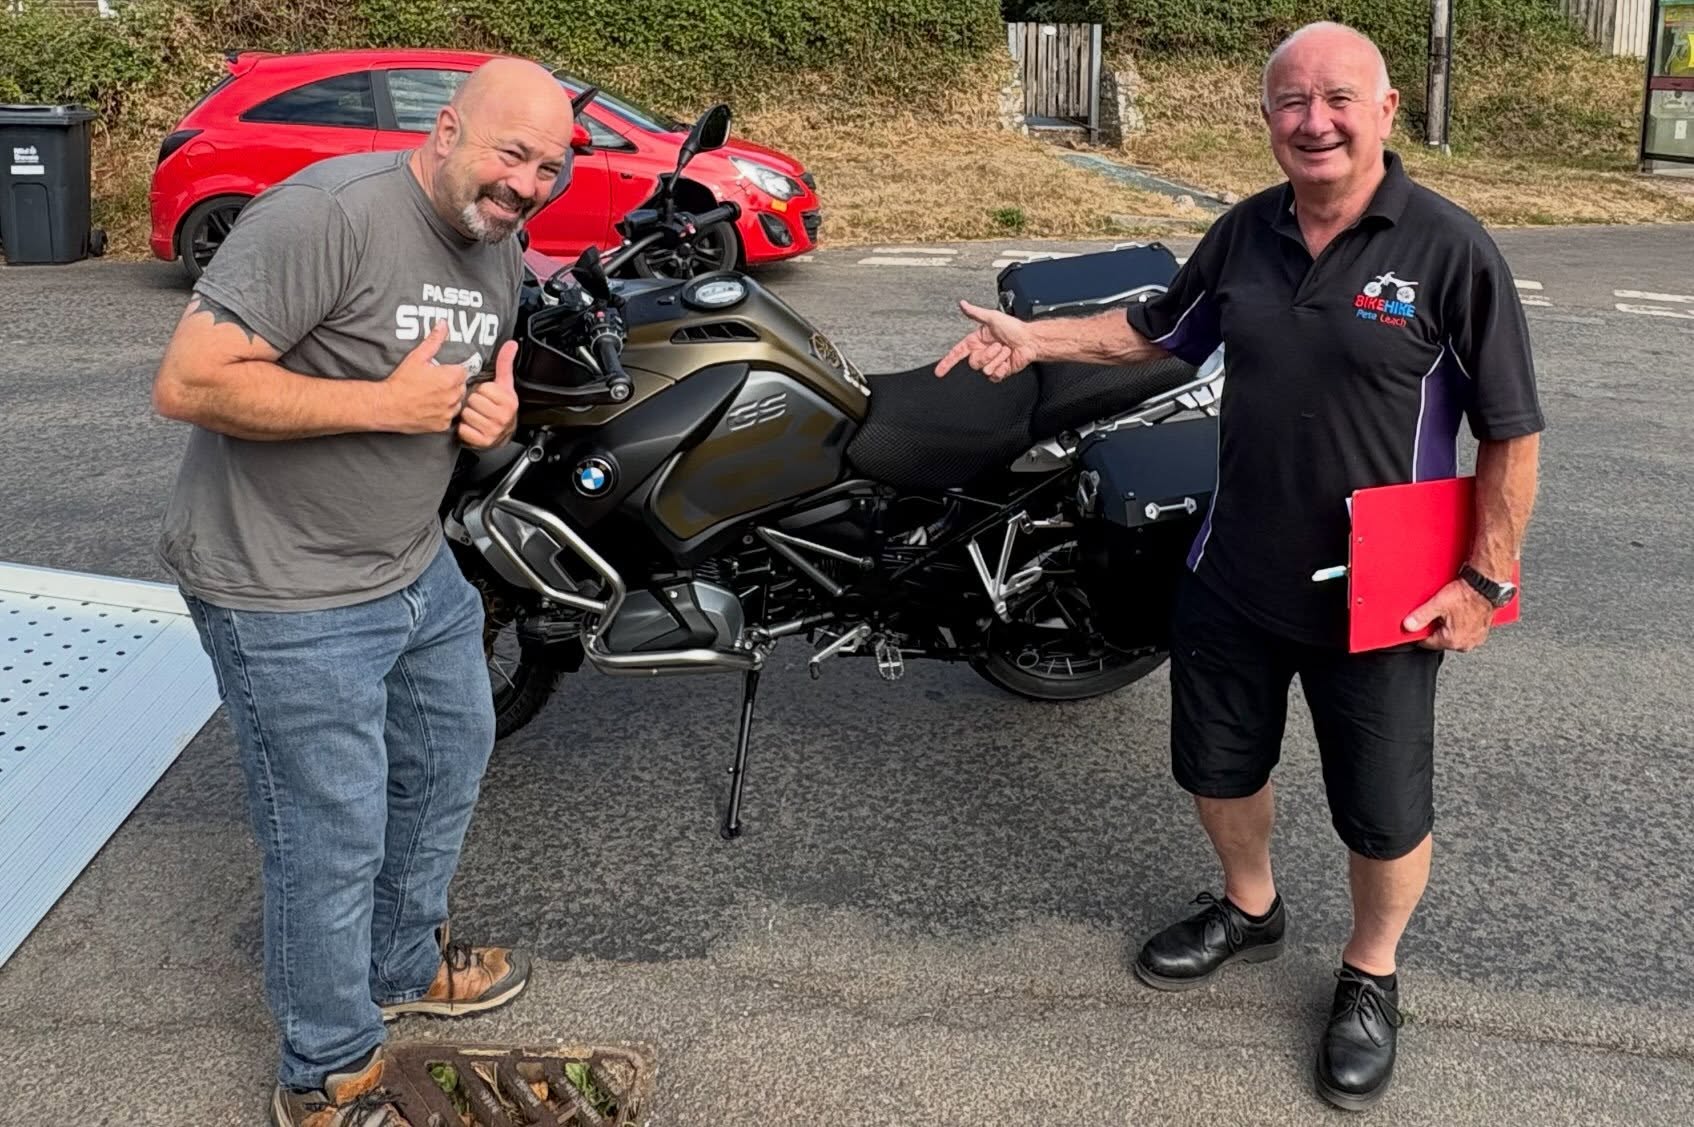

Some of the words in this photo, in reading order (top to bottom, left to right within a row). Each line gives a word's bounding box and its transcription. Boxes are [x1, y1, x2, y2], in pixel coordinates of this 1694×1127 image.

[423, 284, 483, 307] PASSO
[1355, 296, 1416, 318] BIKEHIKE
[727, 392, 787, 432] GS
